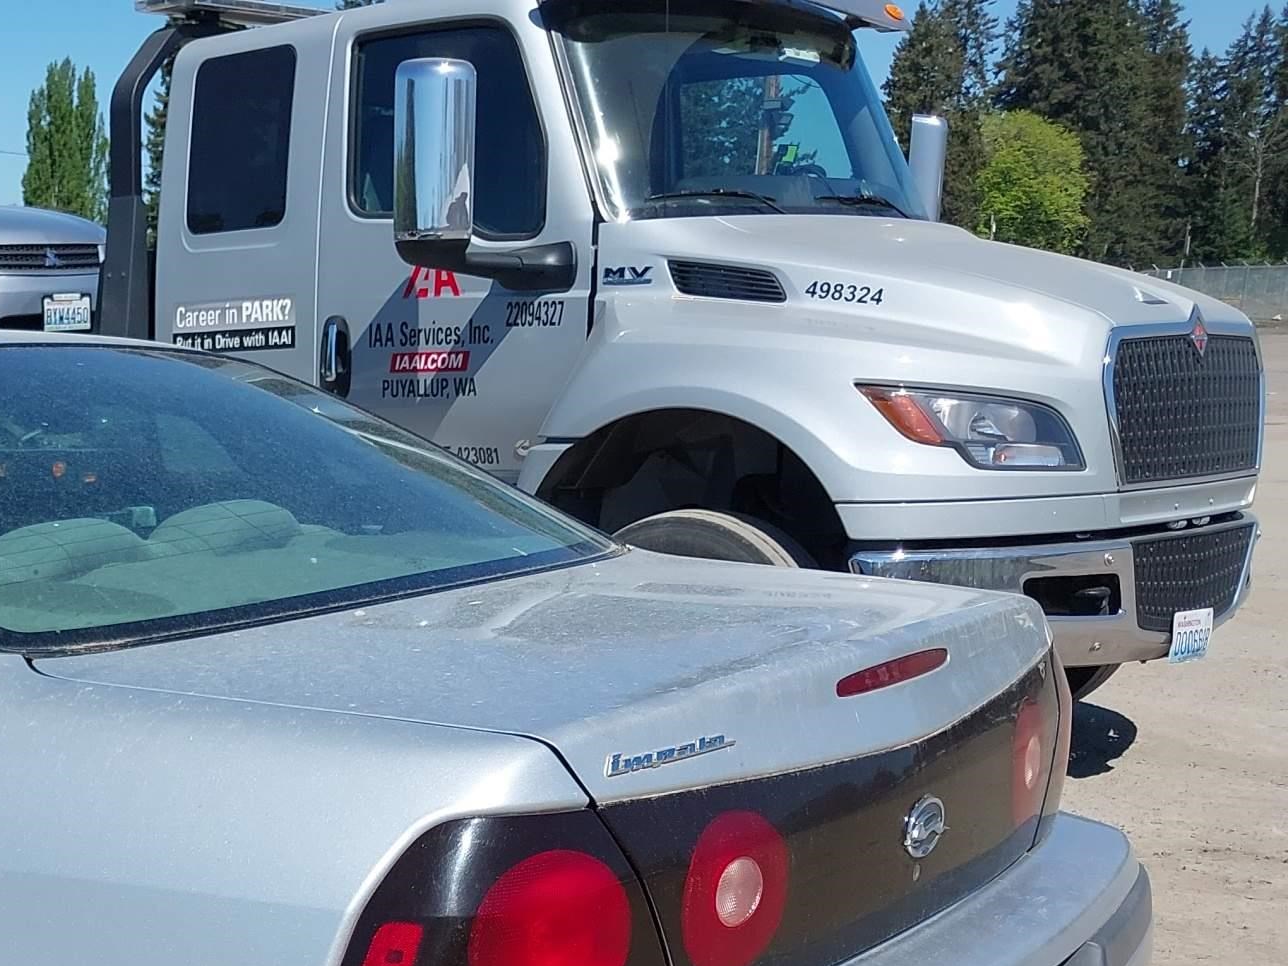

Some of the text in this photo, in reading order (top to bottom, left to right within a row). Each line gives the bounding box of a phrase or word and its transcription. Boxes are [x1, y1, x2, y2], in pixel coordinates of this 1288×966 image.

[604, 266, 654, 279] MV
[805, 280, 885, 306] 498324
[176, 298, 292, 328] Career in PARK?
[505, 300, 565, 328] 22094327
[194, 334, 202, 350] it
[203, 334, 213, 350] in
[215, 333, 241, 349] Drive
[243, 332, 266, 348] with
[268, 328, 292, 346] IAAI
[368, 319, 494, 349] IAA Services, Inc.
[395, 353, 463, 371] IAAI.COM
[382, 377, 477, 399] PUYALLUP, WA
